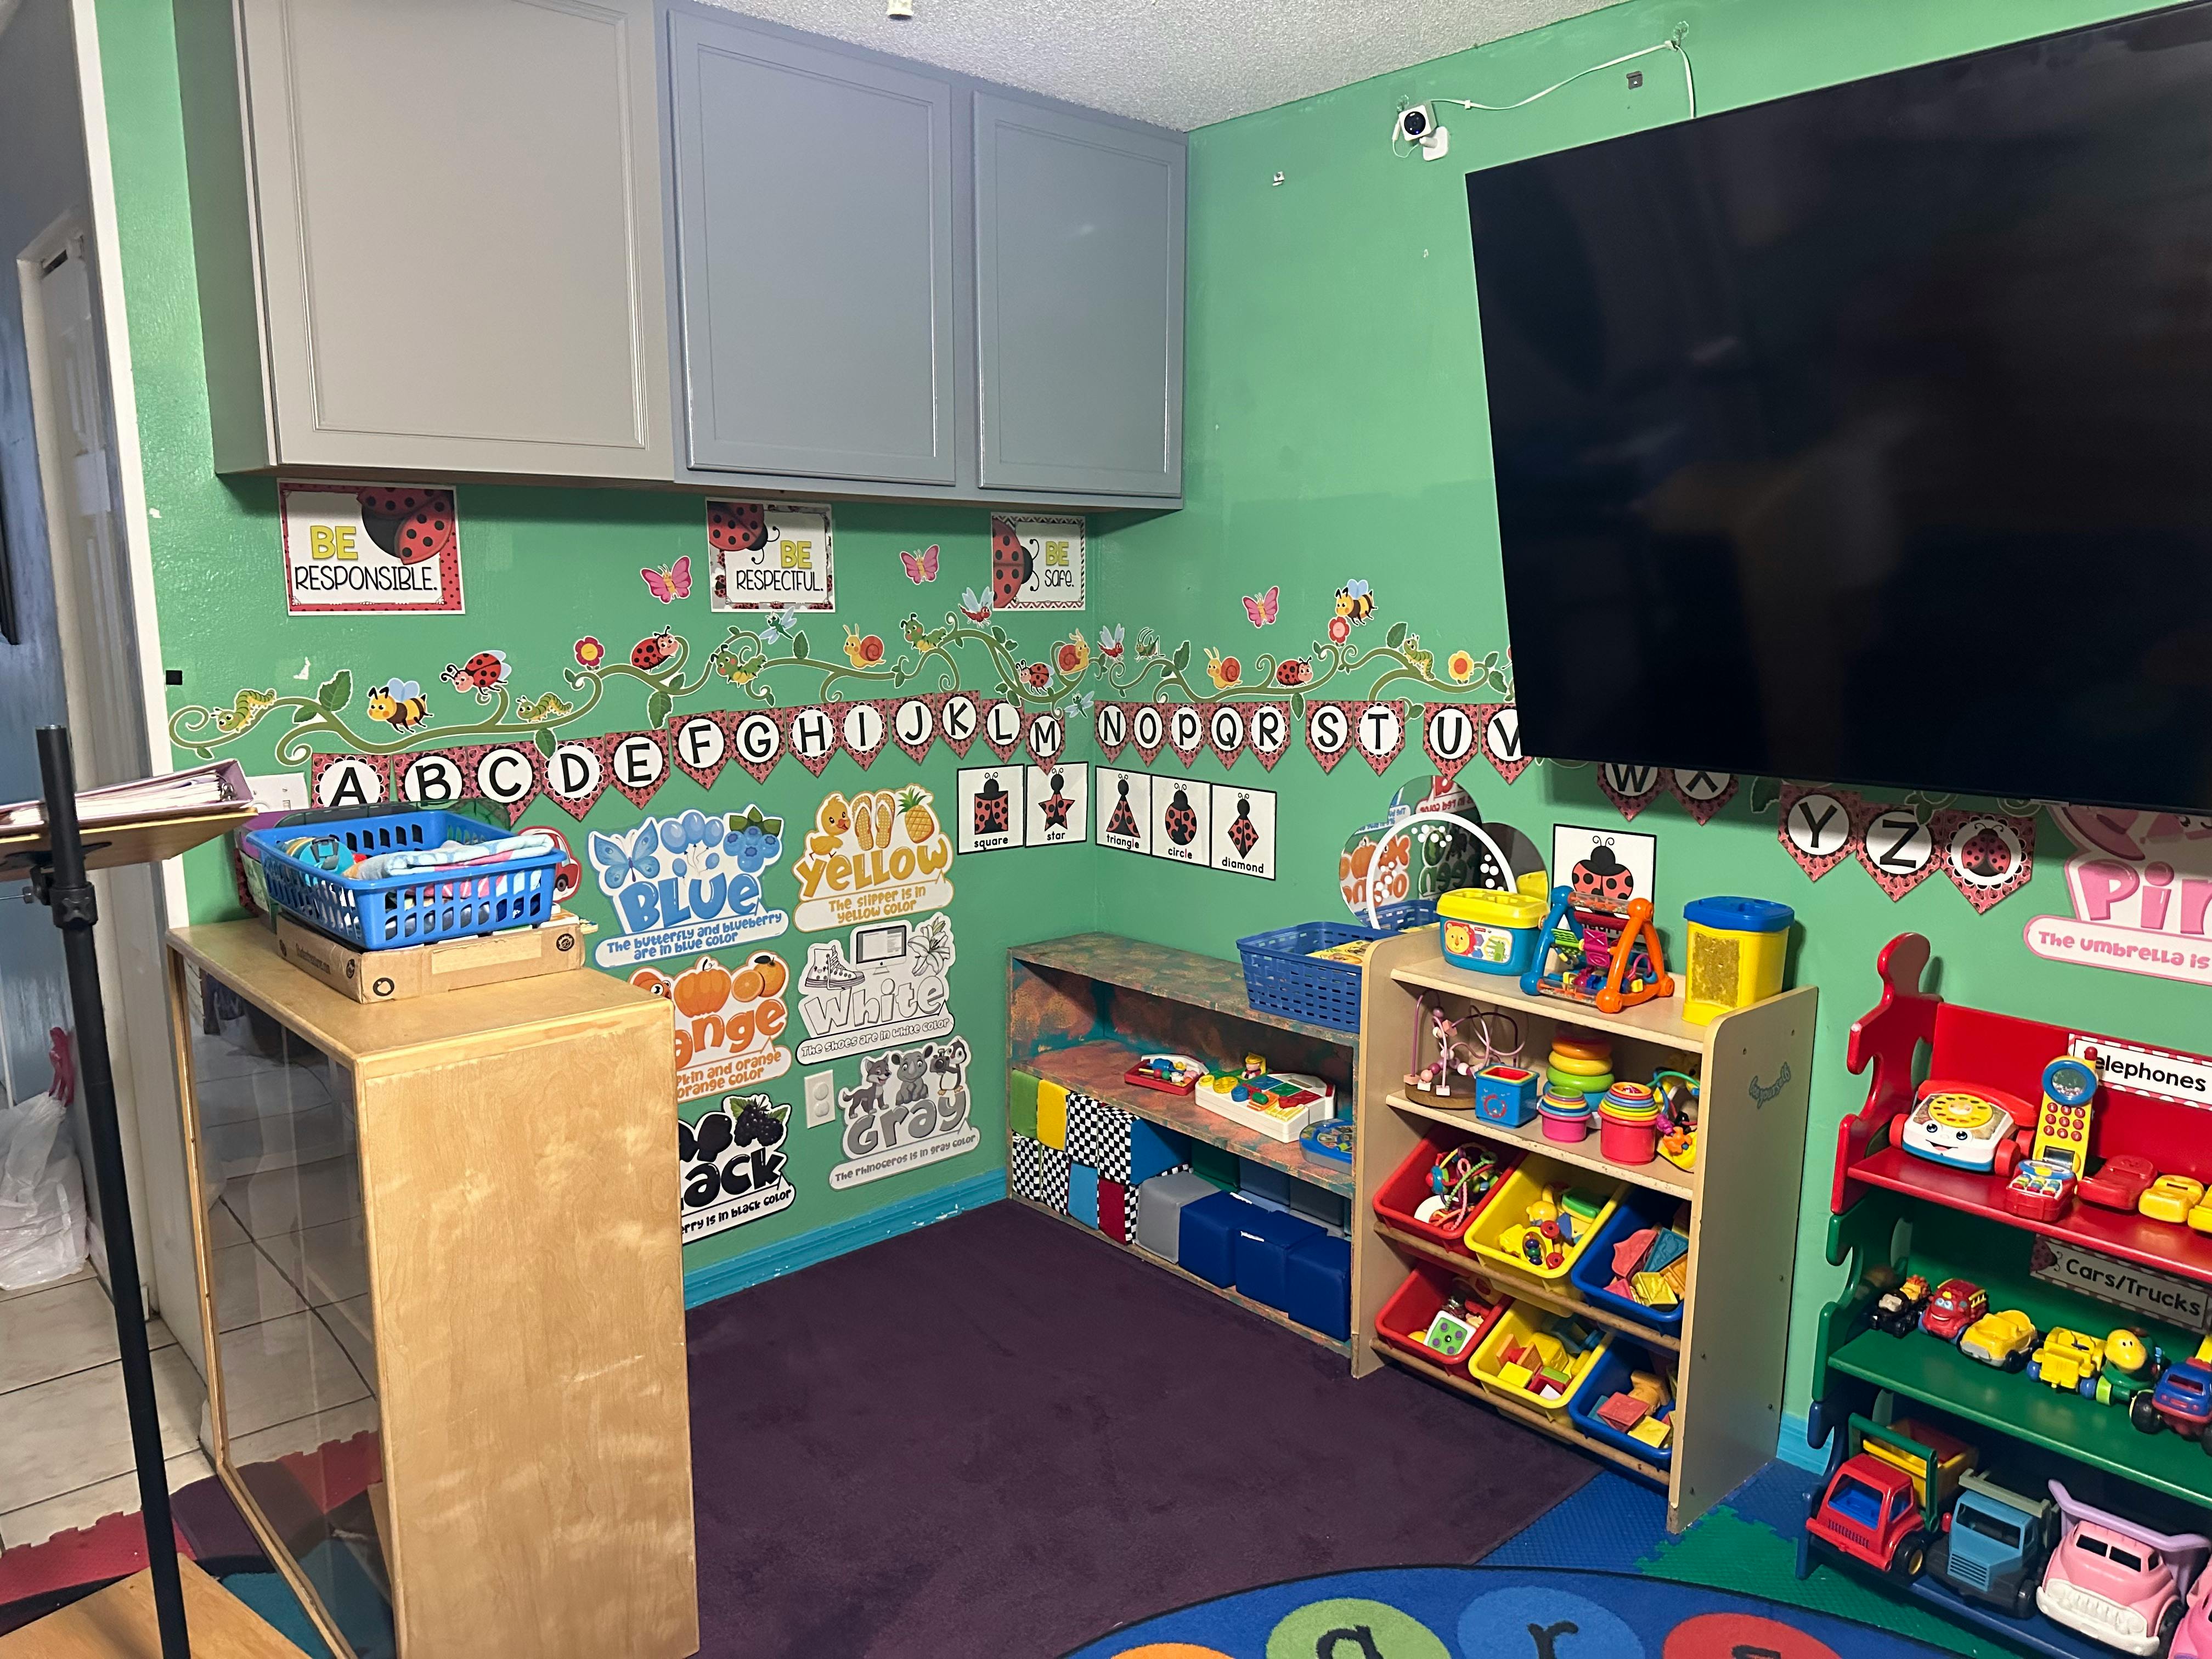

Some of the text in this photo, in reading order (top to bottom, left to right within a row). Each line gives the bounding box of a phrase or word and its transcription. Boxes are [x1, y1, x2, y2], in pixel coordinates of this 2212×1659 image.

[311, 526, 359, 560] BE
[780, 540, 814, 569] BE
[1045, 541, 1069, 566] BE
[295, 566, 438, 591] RESPONSIBLE.
[736, 569, 824, 592] RESPECTFUL.
[1103, 711, 1121, 743] N
[1138, 712, 1158, 742] O
[1179, 714, 1197, 746] P
[1216, 713, 1237, 748] Q
[1257, 711, 1280, 748] R
[1316, 712, 1339, 747] S
[1367, 713, 1390, 750] T
[1437, 716, 1462, 754] U
[329, 703, 1057, 806] A B C D E F G H I J K L M
[1611, 763, 1651, 792] W
[973, 836, 1008, 850] square
[1046, 830, 1065, 841] star
[1106, 833, 1139, 849] triangle
[1798, 802, 1919, 868] Y Z
[1167, 847, 1193, 859] circle
[1221, 857, 1264, 874] diamond
[828, 886, 926, 912] The slipper is in
[607, 912, 782, 953] The butterfly and blueberry
[634, 947, 657, 960] are
[659, 944, 672, 955] in
[2039, 931, 2211, 969] The umbrella is
[804, 975, 945, 1035] White
[802, 1044, 822, 1057] The
[859, 1033, 878, 1045] are
[880, 1030, 890, 1041] in
[892, 1024, 920, 1037] white
[707, 1062, 732, 1079] and
[736, 1051, 782, 1070] orange
[2095, 1055, 2207, 1092] elephones
[677, 1077, 725, 1098] orange
[847, 1092, 967, 1154] Gray
[835, 1170, 854, 1182] The
[855, 1154, 908, 1176] rhinoceros
[910, 1150, 918, 1160] is
[920, 1147, 929, 1157] in
[930, 1141, 951, 1155] gray
[682, 1147, 785, 1209] ack
[706, 1215, 716, 1226] is
[718, 1211, 729, 1222] in
[731, 1200, 761, 1218] black
[2066, 1258, 2200, 1317] Cars/Trucks
